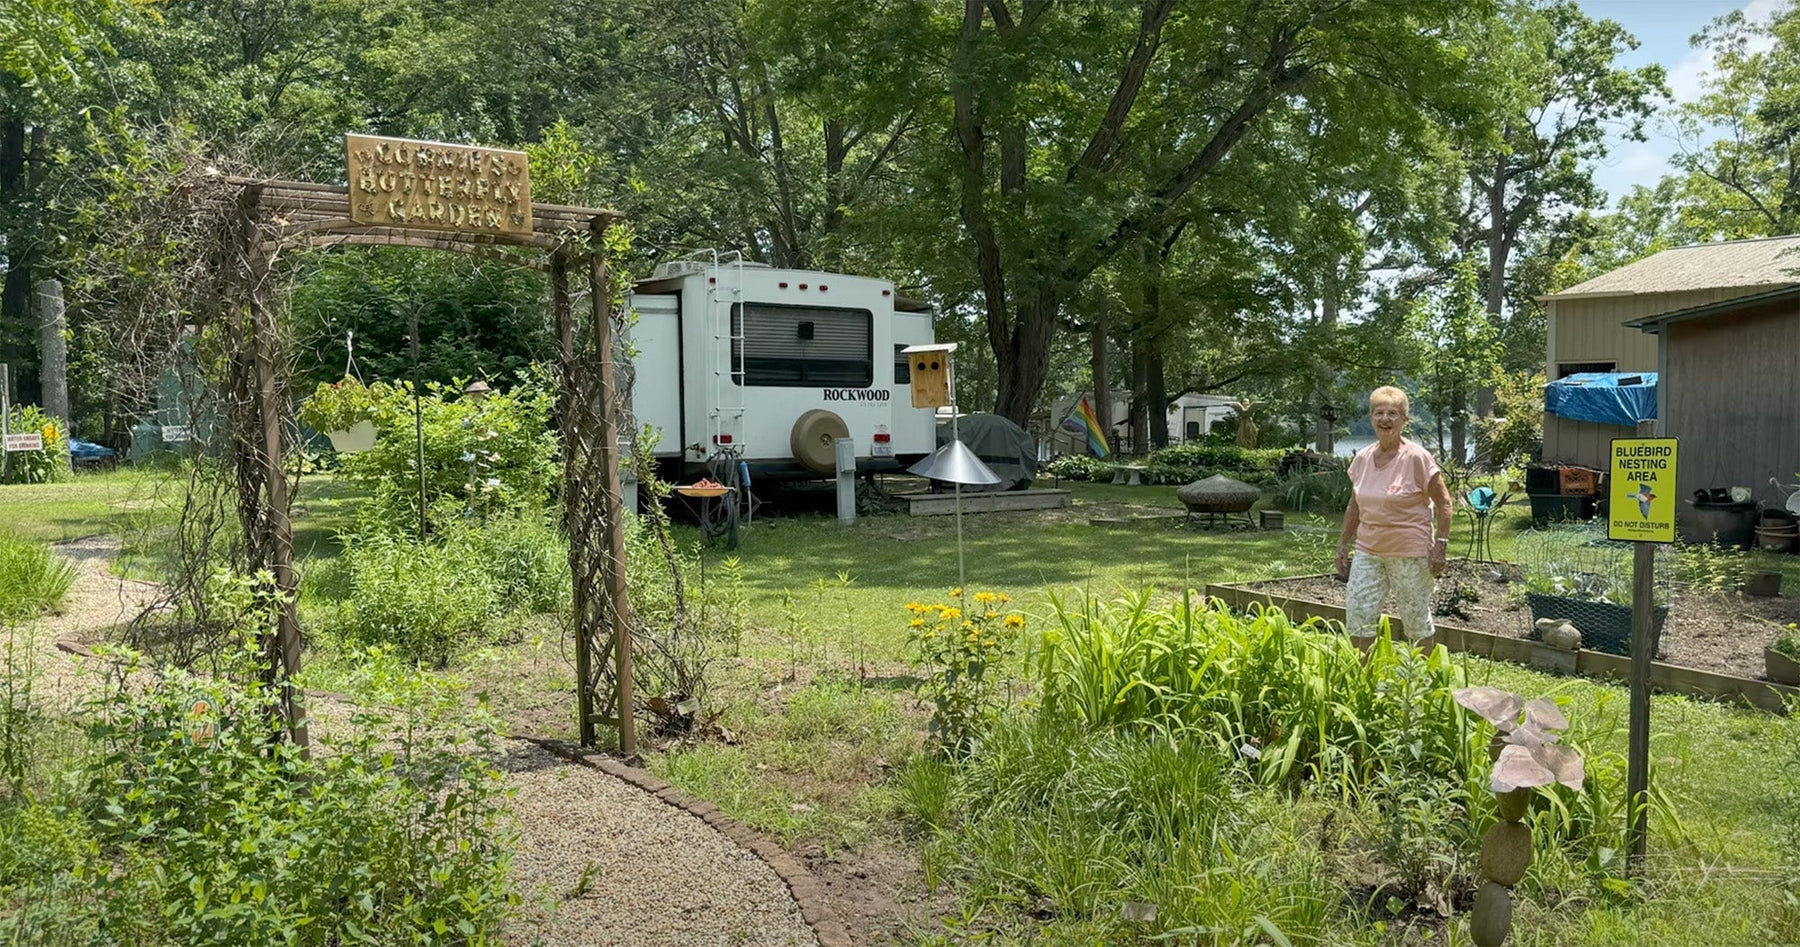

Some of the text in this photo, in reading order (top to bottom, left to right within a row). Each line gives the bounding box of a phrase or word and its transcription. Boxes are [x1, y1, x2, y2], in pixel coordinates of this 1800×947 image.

[359, 167, 522, 206] BUTTERFLY
[388, 199, 502, 228] GARDEN
[823, 389, 890, 401] ROCKWOOD
[1616, 446, 1672, 457] BLUEBIRD
[1619, 459, 1667, 469] NESTING
[1627, 471, 1657, 481] AREA
[1624, 521, 1638, 529] NOT
[1640, 522, 1670, 530] DISTURB
